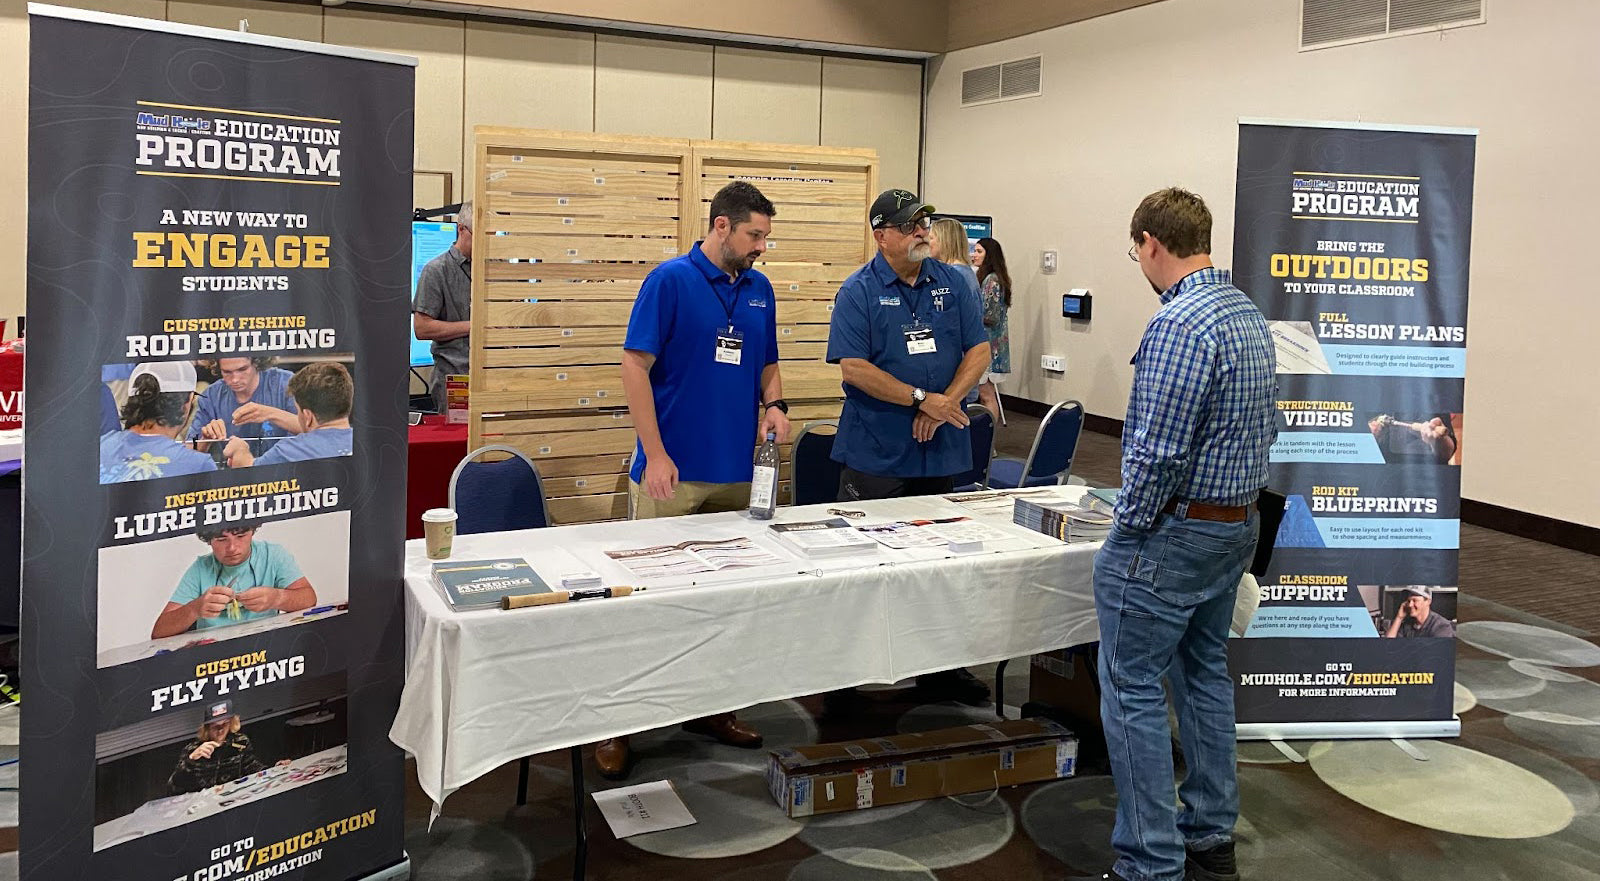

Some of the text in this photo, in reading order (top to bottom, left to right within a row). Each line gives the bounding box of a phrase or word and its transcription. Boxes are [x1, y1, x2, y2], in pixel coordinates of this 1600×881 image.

[136, 112, 169, 127] Mud
[214, 118, 340, 146] EDUCATION
[136, 134, 340, 177] PROGRAM
[1336, 181, 1420, 196] EDUCATION
[1292, 193, 1419, 217] PROGRAM
[160, 209, 308, 228] A NEW WAY TO
[132, 232, 330, 268] ENGAGE
[1317, 240, 1384, 253] BRING THE
[1270, 254, 1429, 282] OUTDOORS
[182, 276, 289, 292] STUDENTS
[930, 288, 950, 296] BUZZ
[1284, 282, 1414, 296] TO YOUR CLASSROOM
[164, 316, 306, 332] CUSTOM FISHING
[1319, 313, 1349, 322] FULL
[1318, 324, 1464, 342] LESSON PLANS
[126, 328, 336, 358] ROD BUILDING
[1276, 401, 1354, 410] STRUCTIONAL
[1283, 410, 1354, 426] VIDEOS
[164, 479, 300, 508] INSTRUCTIONAL
[1312, 486, 1360, 496] ROD KIT
[1312, 496, 1438, 513] BLUEPRINTS
[114, 487, 339, 540] LURE BUILDING
[1280, 575, 1348, 584] CLASSROOM
[1260, 586, 1348, 602] SUPPORT
[196, 650, 267, 678] CUSTOM
[1326, 663, 1352, 672] GO TO
[150, 656, 305, 712] FLY TYING
[1241, 672, 1434, 686] MUDHOLE.COM/EDUCATION
[1279, 688, 1396, 697] FOR MORE INFORMATION
[210, 836, 254, 861] GO TO
[234, 849, 322, 881] ORMATION
